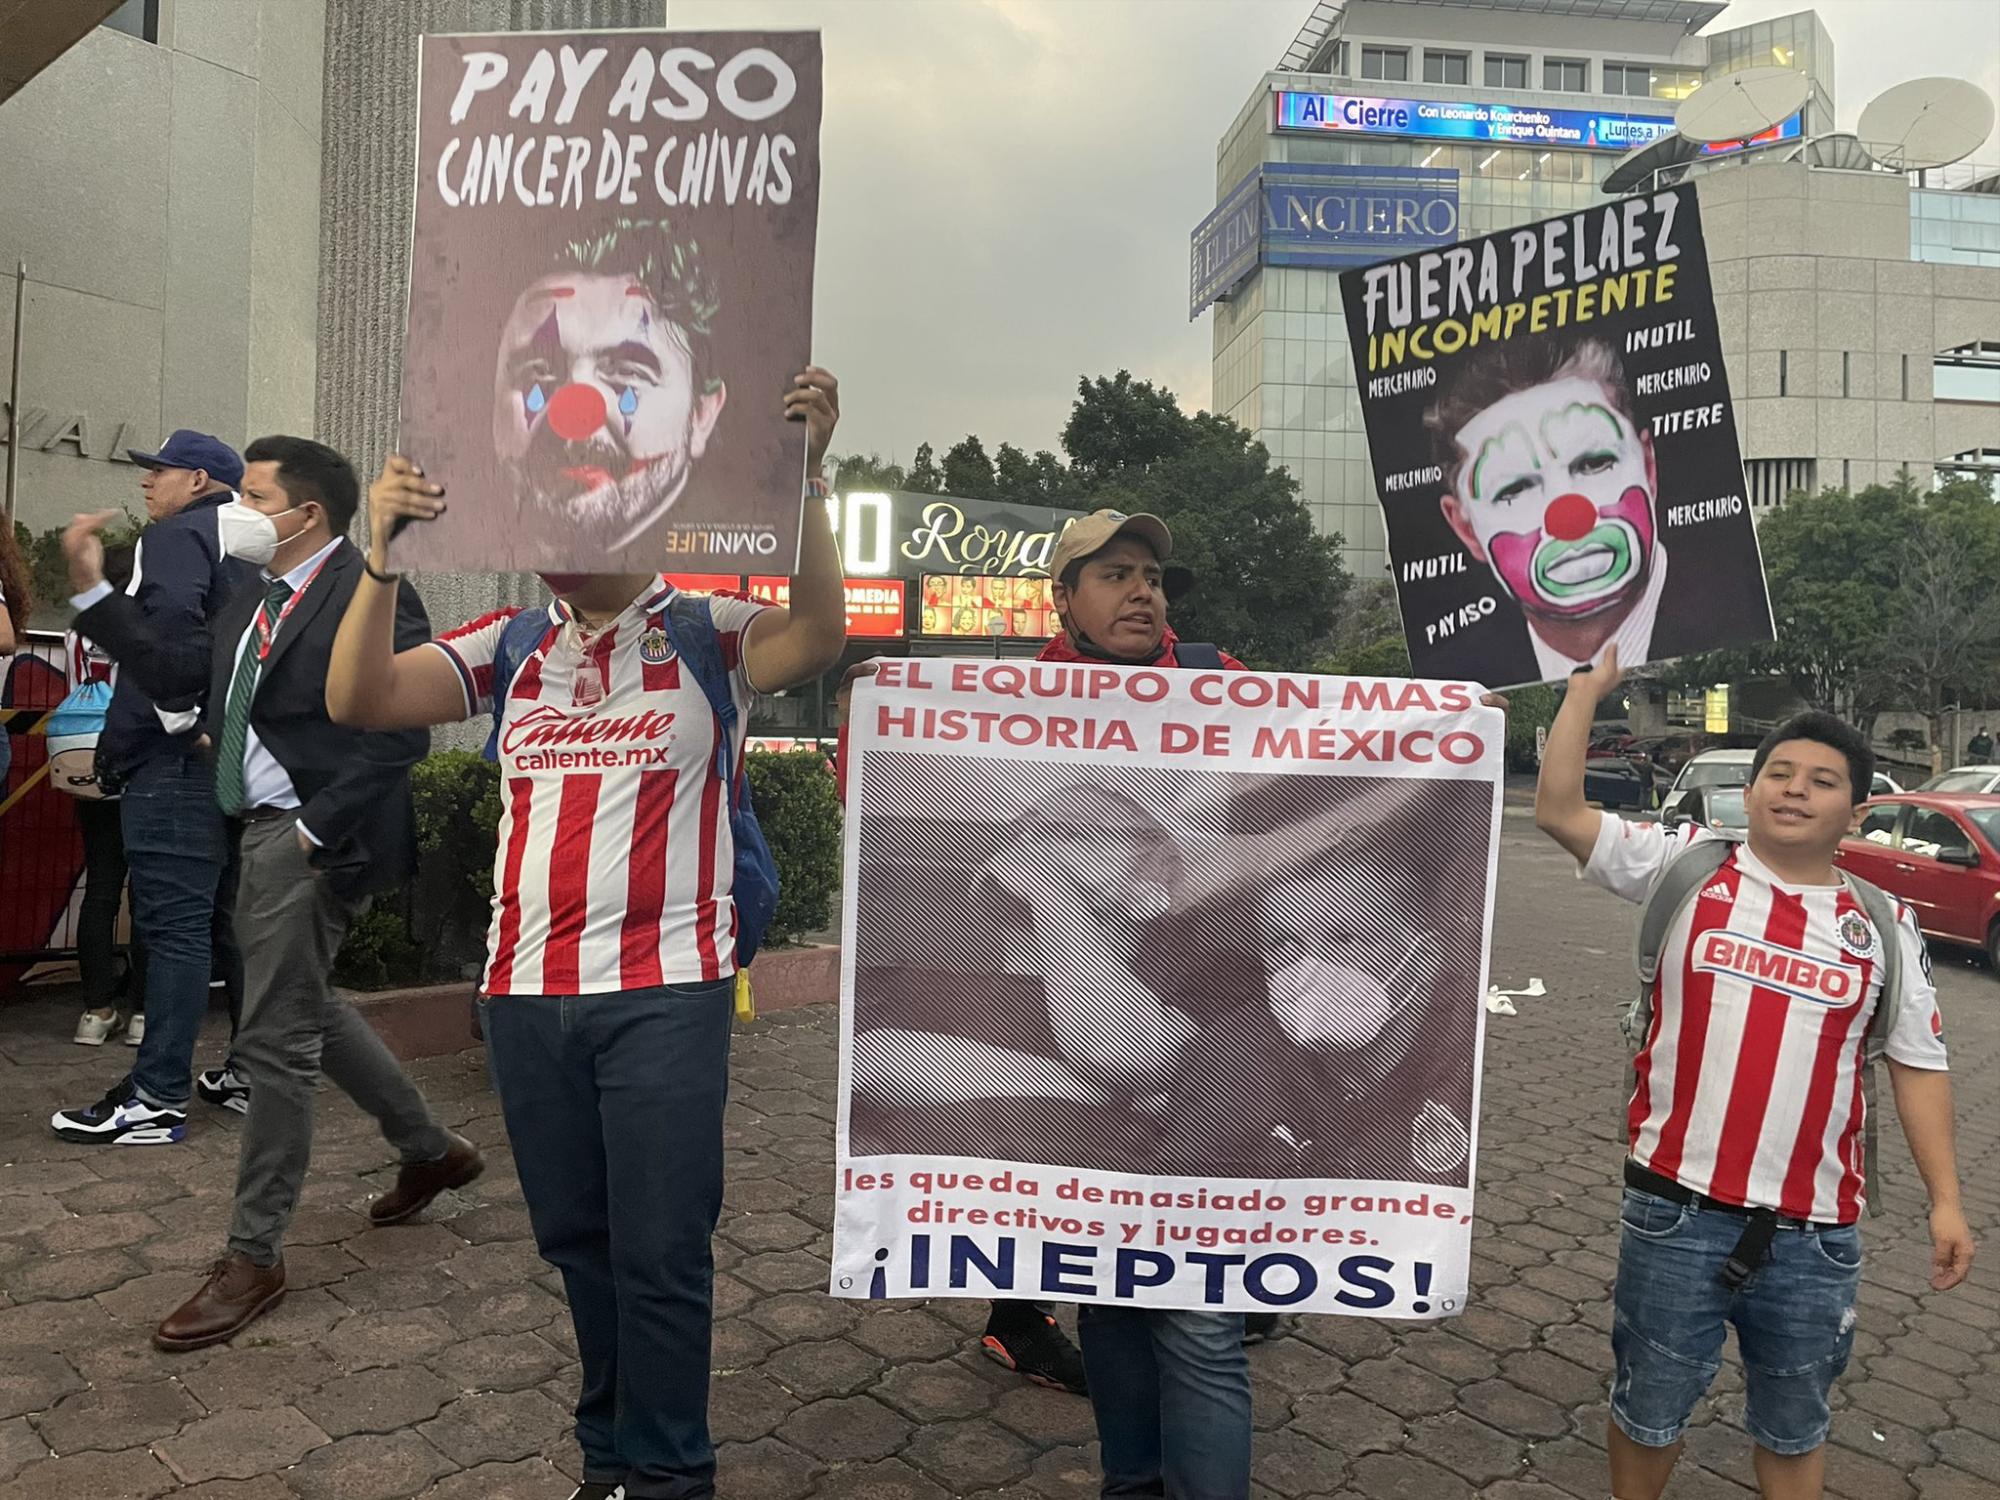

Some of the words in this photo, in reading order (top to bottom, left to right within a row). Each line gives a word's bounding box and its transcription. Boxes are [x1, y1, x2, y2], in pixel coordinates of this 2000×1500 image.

[449, 45, 796, 124] PAYASO
[1343, 100, 1409, 128] Cierre
[1418, 105, 1439, 118] Con
[1440, 106, 1488, 122] Leonardo
[1490, 109, 1550, 125] Kourchenko
[1609, 122, 1643, 138] Lunes
[1646, 127, 1653, 138] a
[1488, 124, 1497, 137] y
[1497, 123, 1534, 138] Enrique
[1535, 125, 1581, 140] Quintana
[437, 133, 592, 210] CANCER
[596, 128, 648, 204] DE
[655, 129, 796, 208] CHIVAS
[1363, 238, 1498, 335] FUERA
[1511, 192, 1680, 297] PELAEZ
[1367, 264, 1678, 371] INCOMPETENTE
[1626, 319, 1696, 353] INUTIL
[1368, 366, 1437, 399] MERCENARIO
[1637, 362, 1711, 396] MERCENARIO
[1652, 403, 1724, 437] TITERE
[1385, 465, 1442, 492] MERCENARIO
[1668, 495, 1742, 527] MERCENARIO
[666, 531, 777, 555] OMNILIFE
[1403, 552, 1467, 582] INUTIL
[844, 588, 900, 604] OMEDIA
[1426, 596, 1496, 645] PAYASO
[875, 660, 932, 689] EL
[951, 663, 1169, 702] EQUIPO
[1189, 674, 1320, 709] CON
[1341, 680, 1471, 712] MAS
[502, 705, 676, 755] Caliente
[877, 704, 1138, 752] HISTORIA
[1160, 722, 1229, 757] DE
[1251, 718, 1485, 765] MÉXICO
[515, 744, 669, 771] caliente.mx
[1703, 936, 1850, 998] BIMBO
[844, 1168, 894, 1192] les
[909, 1170, 1039, 1198] queda
[1055, 1177, 1287, 1213] demasiado
[1303, 1187, 1472, 1226] grande,
[907, 1201, 1105, 1237] directivos
[1120, 1221, 1142, 1244] y
[1156, 1219, 1380, 1249] jugadores.
[869, 1234, 1434, 1314] ¡INEPTOS!
